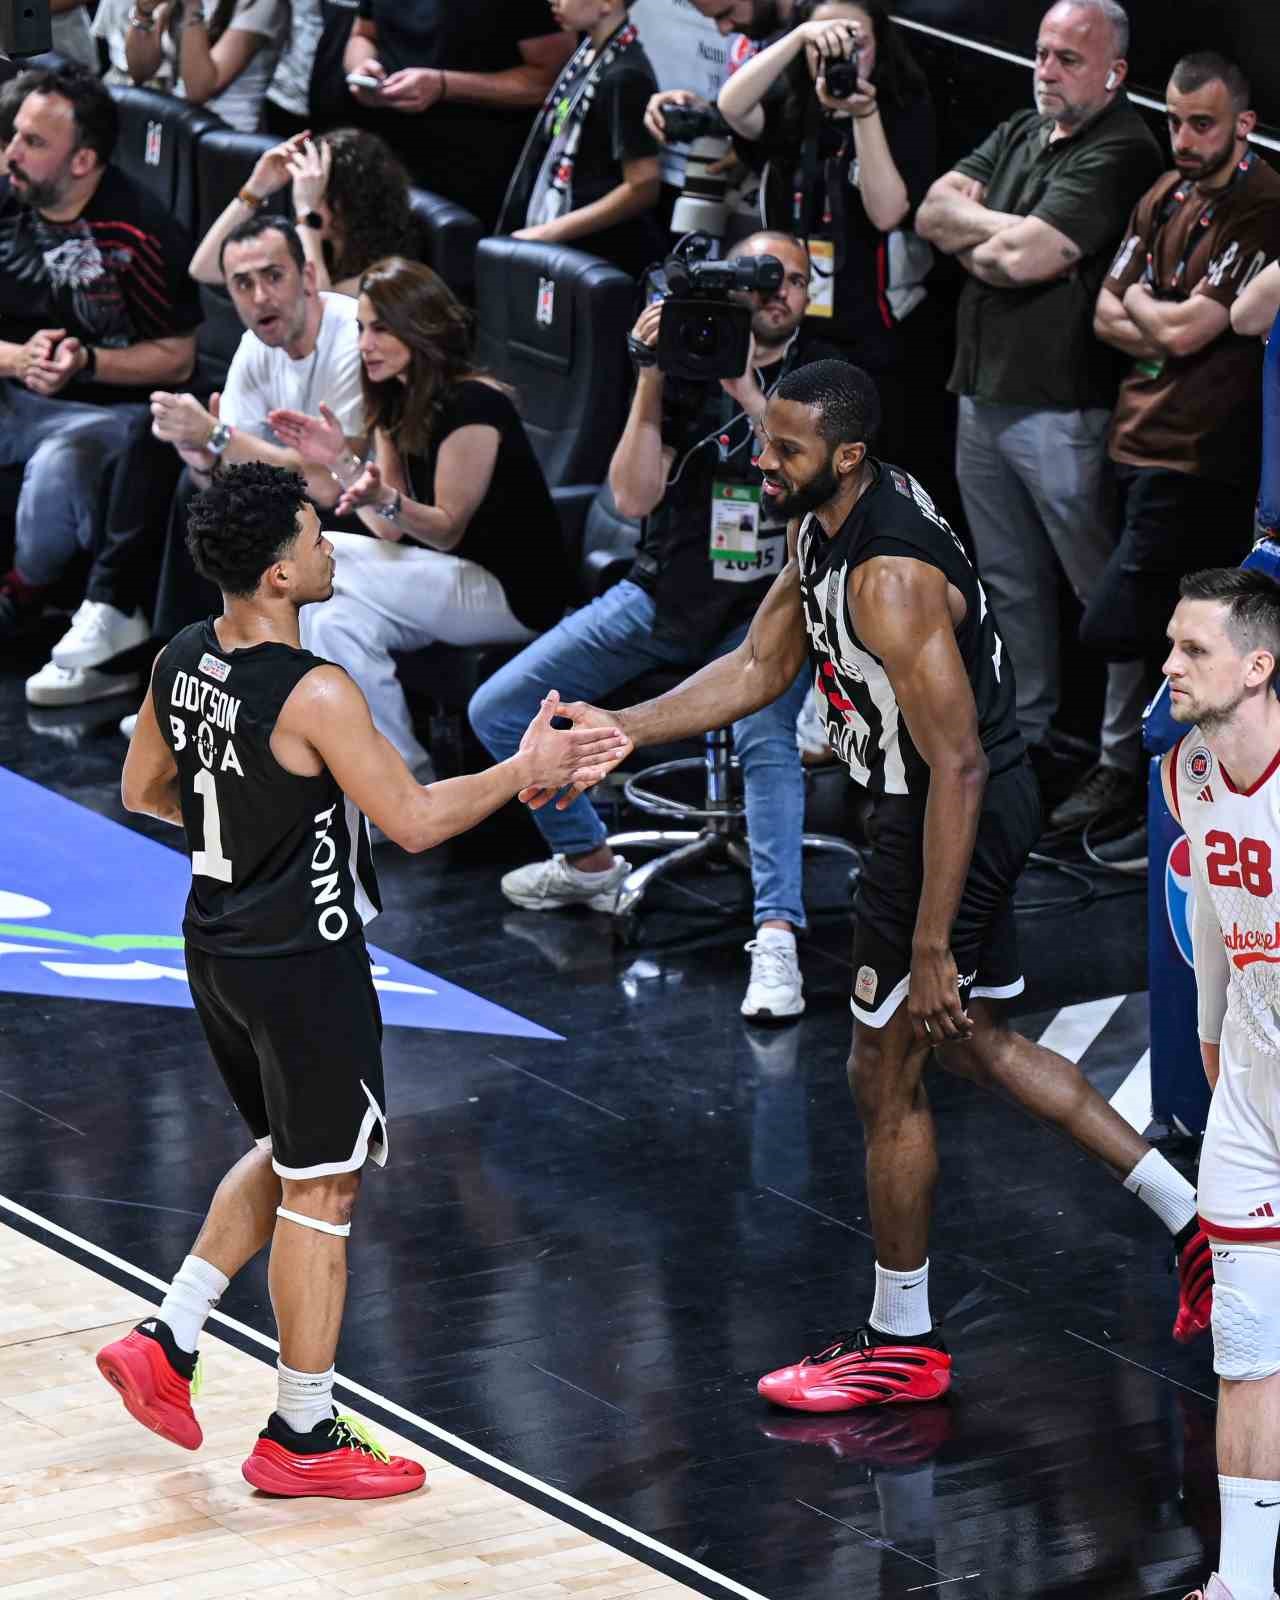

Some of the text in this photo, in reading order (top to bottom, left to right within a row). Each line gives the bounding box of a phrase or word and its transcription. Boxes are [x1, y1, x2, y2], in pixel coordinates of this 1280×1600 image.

[170, 670, 242, 734] DOTSON
[191, 767, 233, 884] 1
[1205, 828, 1273, 898] 28
